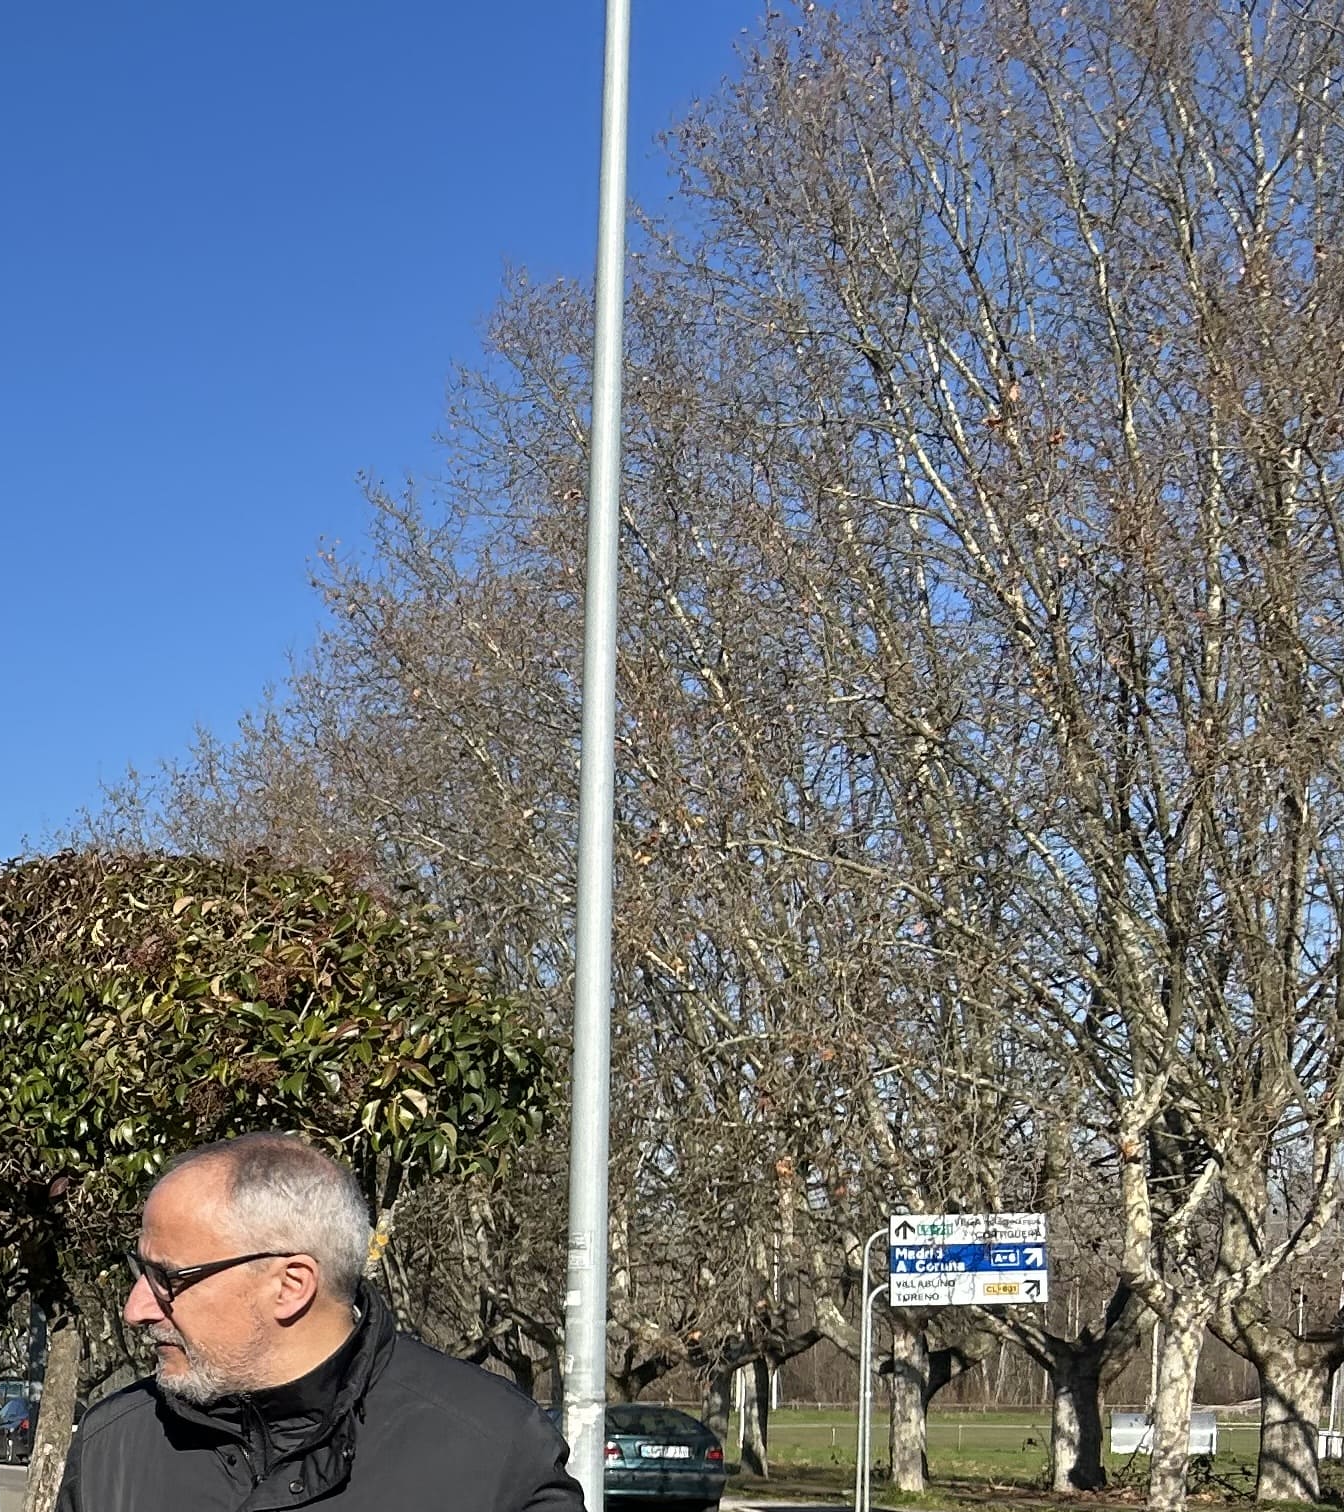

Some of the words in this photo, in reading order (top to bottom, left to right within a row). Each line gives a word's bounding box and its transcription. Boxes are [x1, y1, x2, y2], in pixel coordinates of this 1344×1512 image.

[895, 1247, 943, 1260] Madrid
[994, 1253, 1017, 1263] A-6
[896, 1260, 907, 1272] A
[915, 1259, 966, 1272] Coruña
[896, 1292, 939, 1302] TORENO
